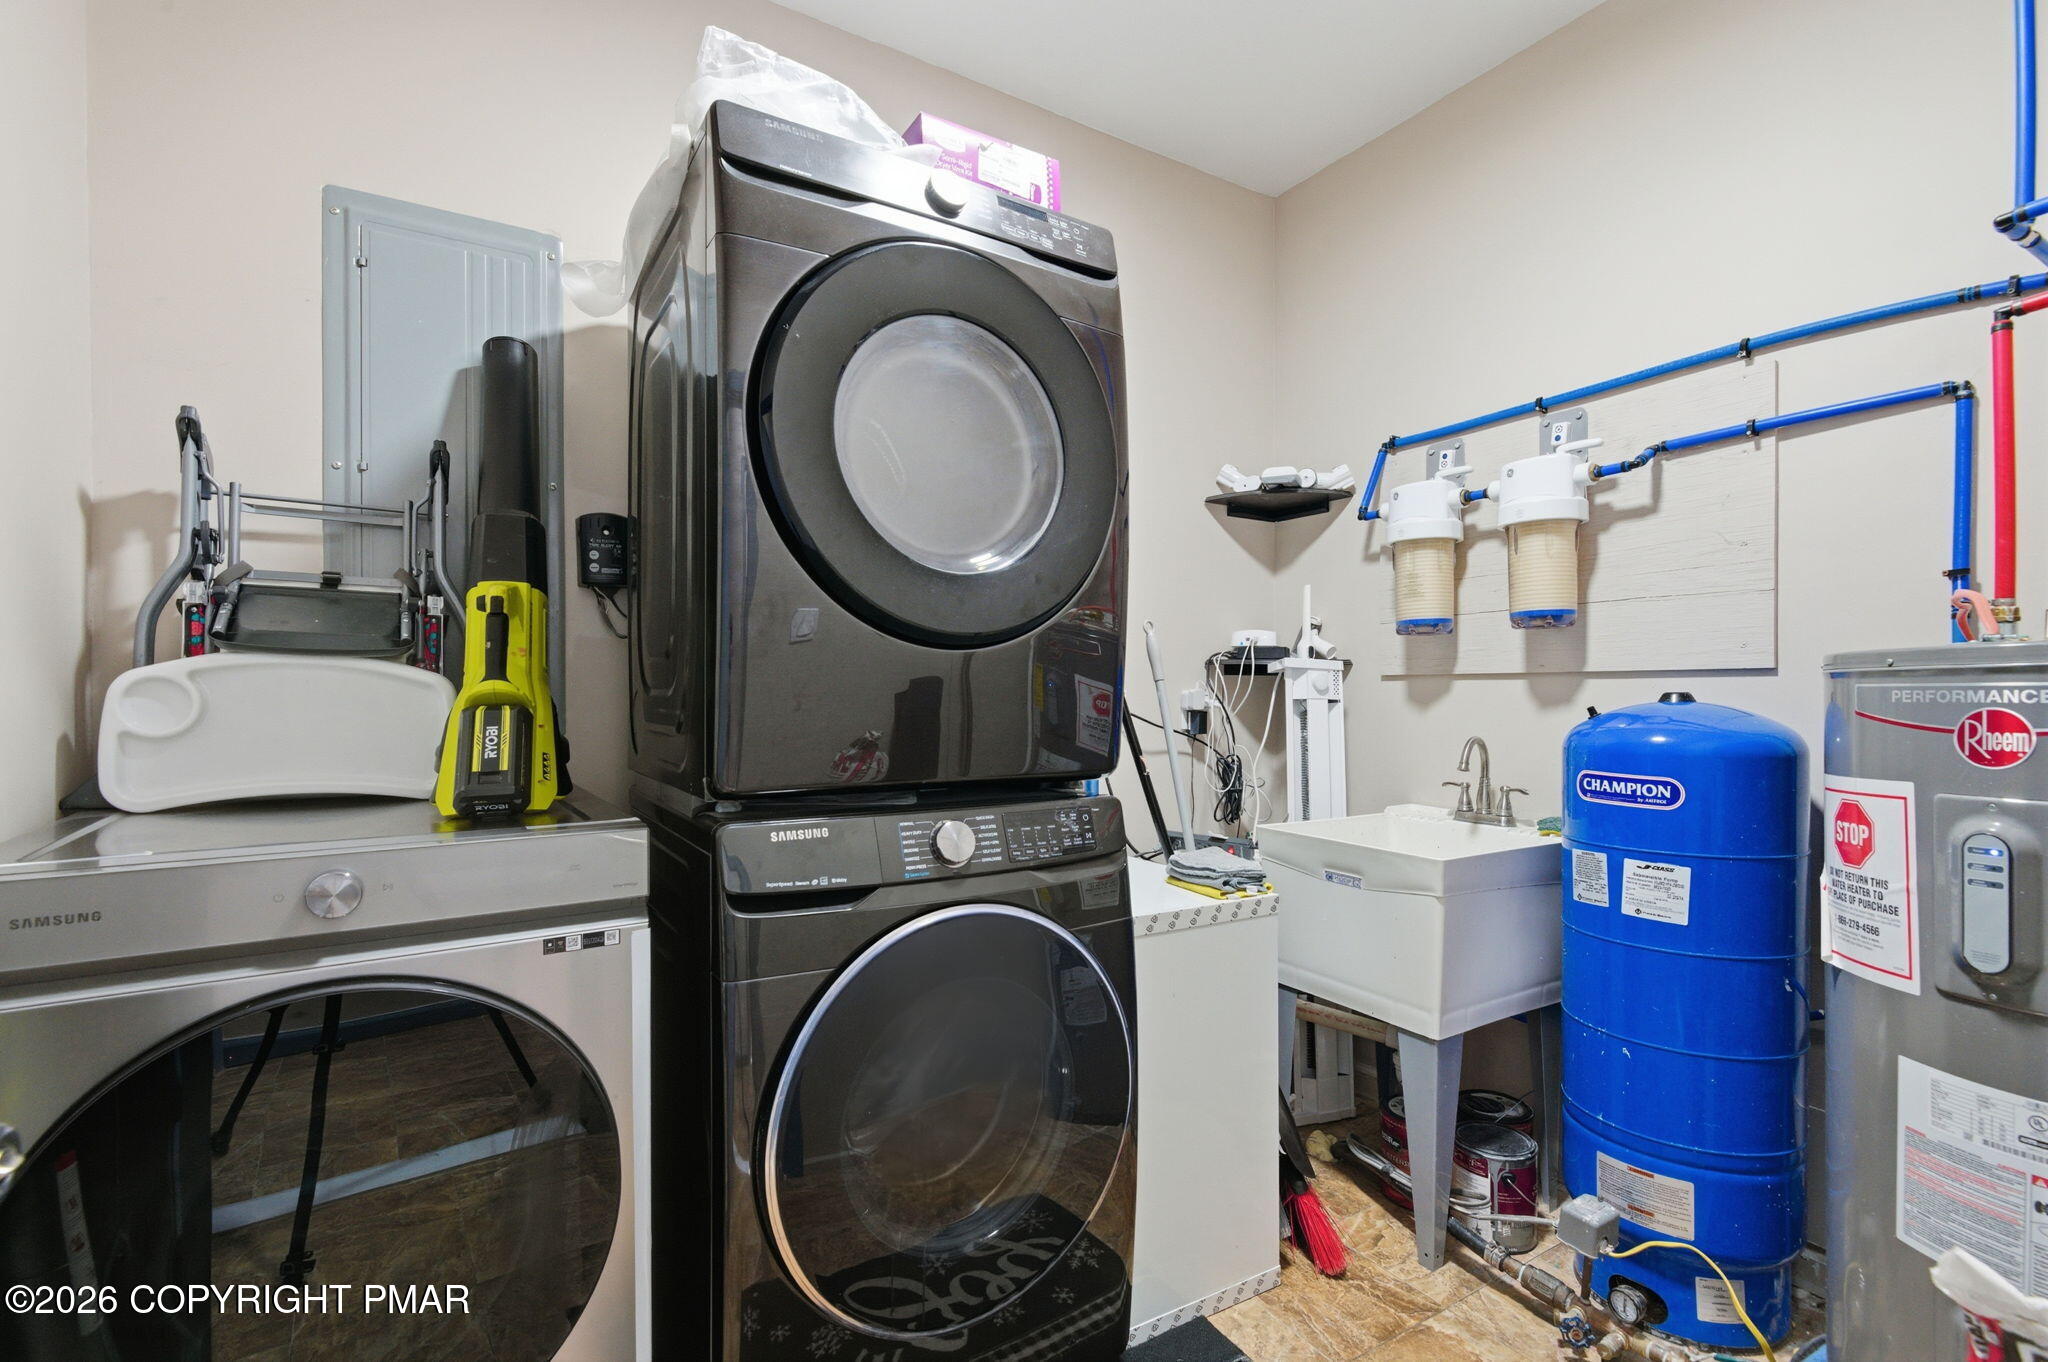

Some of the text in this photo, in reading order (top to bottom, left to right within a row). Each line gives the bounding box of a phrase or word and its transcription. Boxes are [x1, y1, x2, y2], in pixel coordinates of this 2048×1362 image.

[484, 726, 499, 759] RYOBI
[1964, 709, 2030, 760] Rheem
[1583, 777, 1672, 799] CHAMPION
[474, 804, 509, 812] RYOBI
[770, 827, 830, 842] SAMSUNG
[1836, 820, 1870, 846] STOP
[1845, 871, 1869, 885] RETURN
[1870, 877, 1889, 890] THIS
[1847, 884, 1871, 898] HEATER
[1873, 890, 1884, 901] TO
[1848, 894, 1857, 905] OF
[1857, 897, 1900, 917] PURCHASE
[9, 911, 102, 930] SAMSUNG
